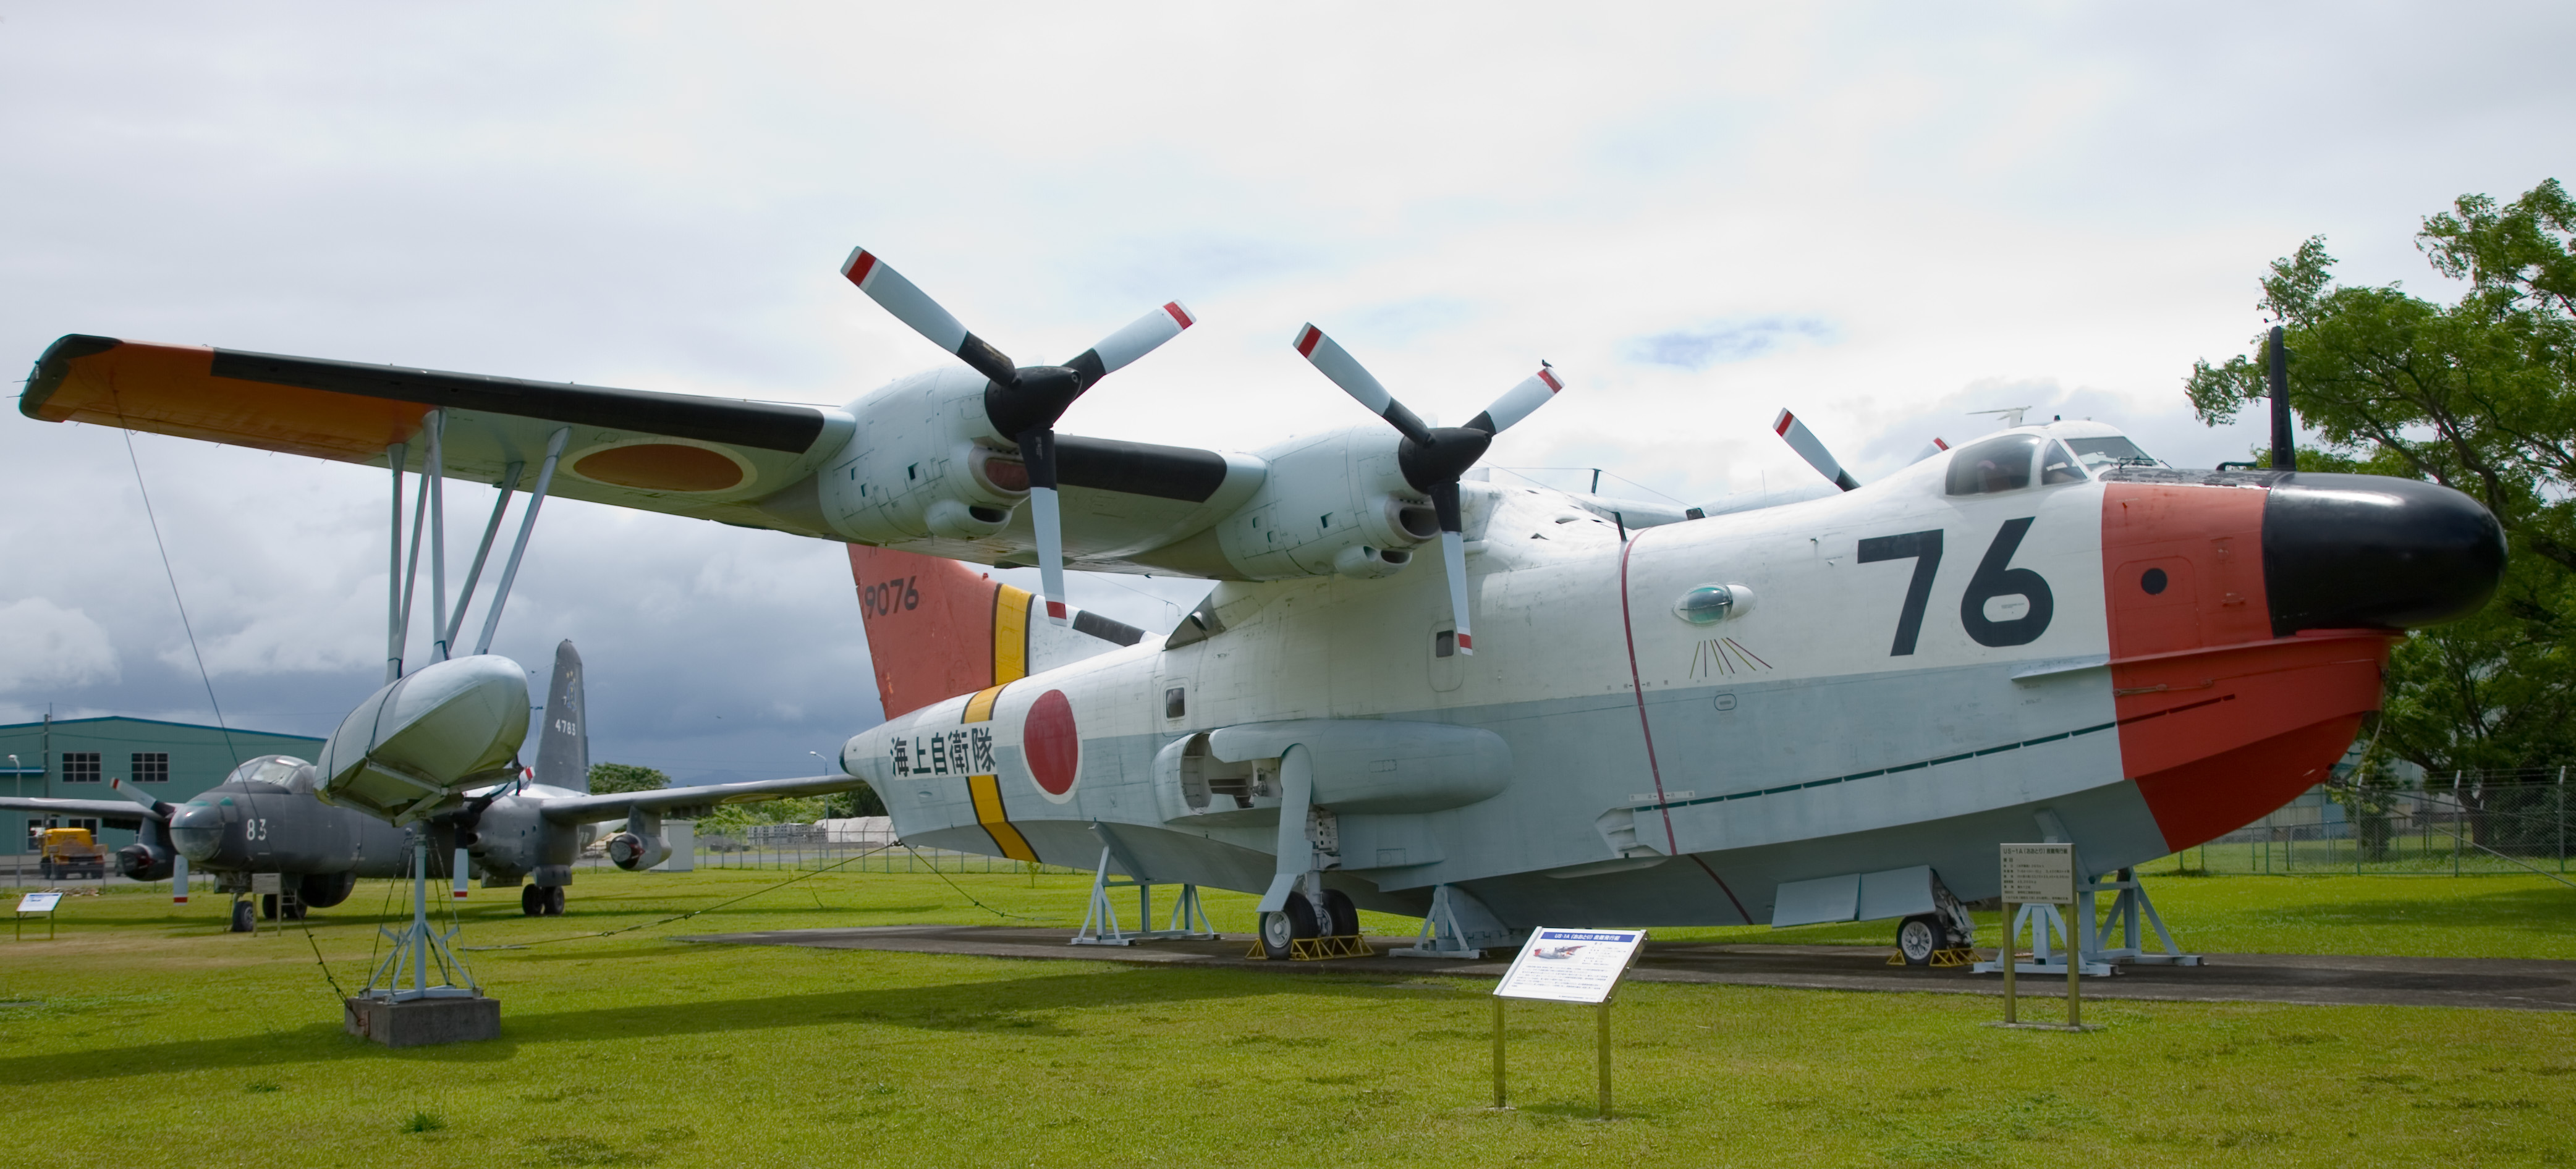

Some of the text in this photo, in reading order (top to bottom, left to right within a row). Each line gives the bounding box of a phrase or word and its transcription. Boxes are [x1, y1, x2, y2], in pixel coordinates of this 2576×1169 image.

[865, 575, 919, 619] 9076
[1857, 516, 2054, 657] 76
[555, 719, 576, 736] 4783
[890, 727, 996, 777] 海上自衛隊
[247, 818, 267, 841] 83
